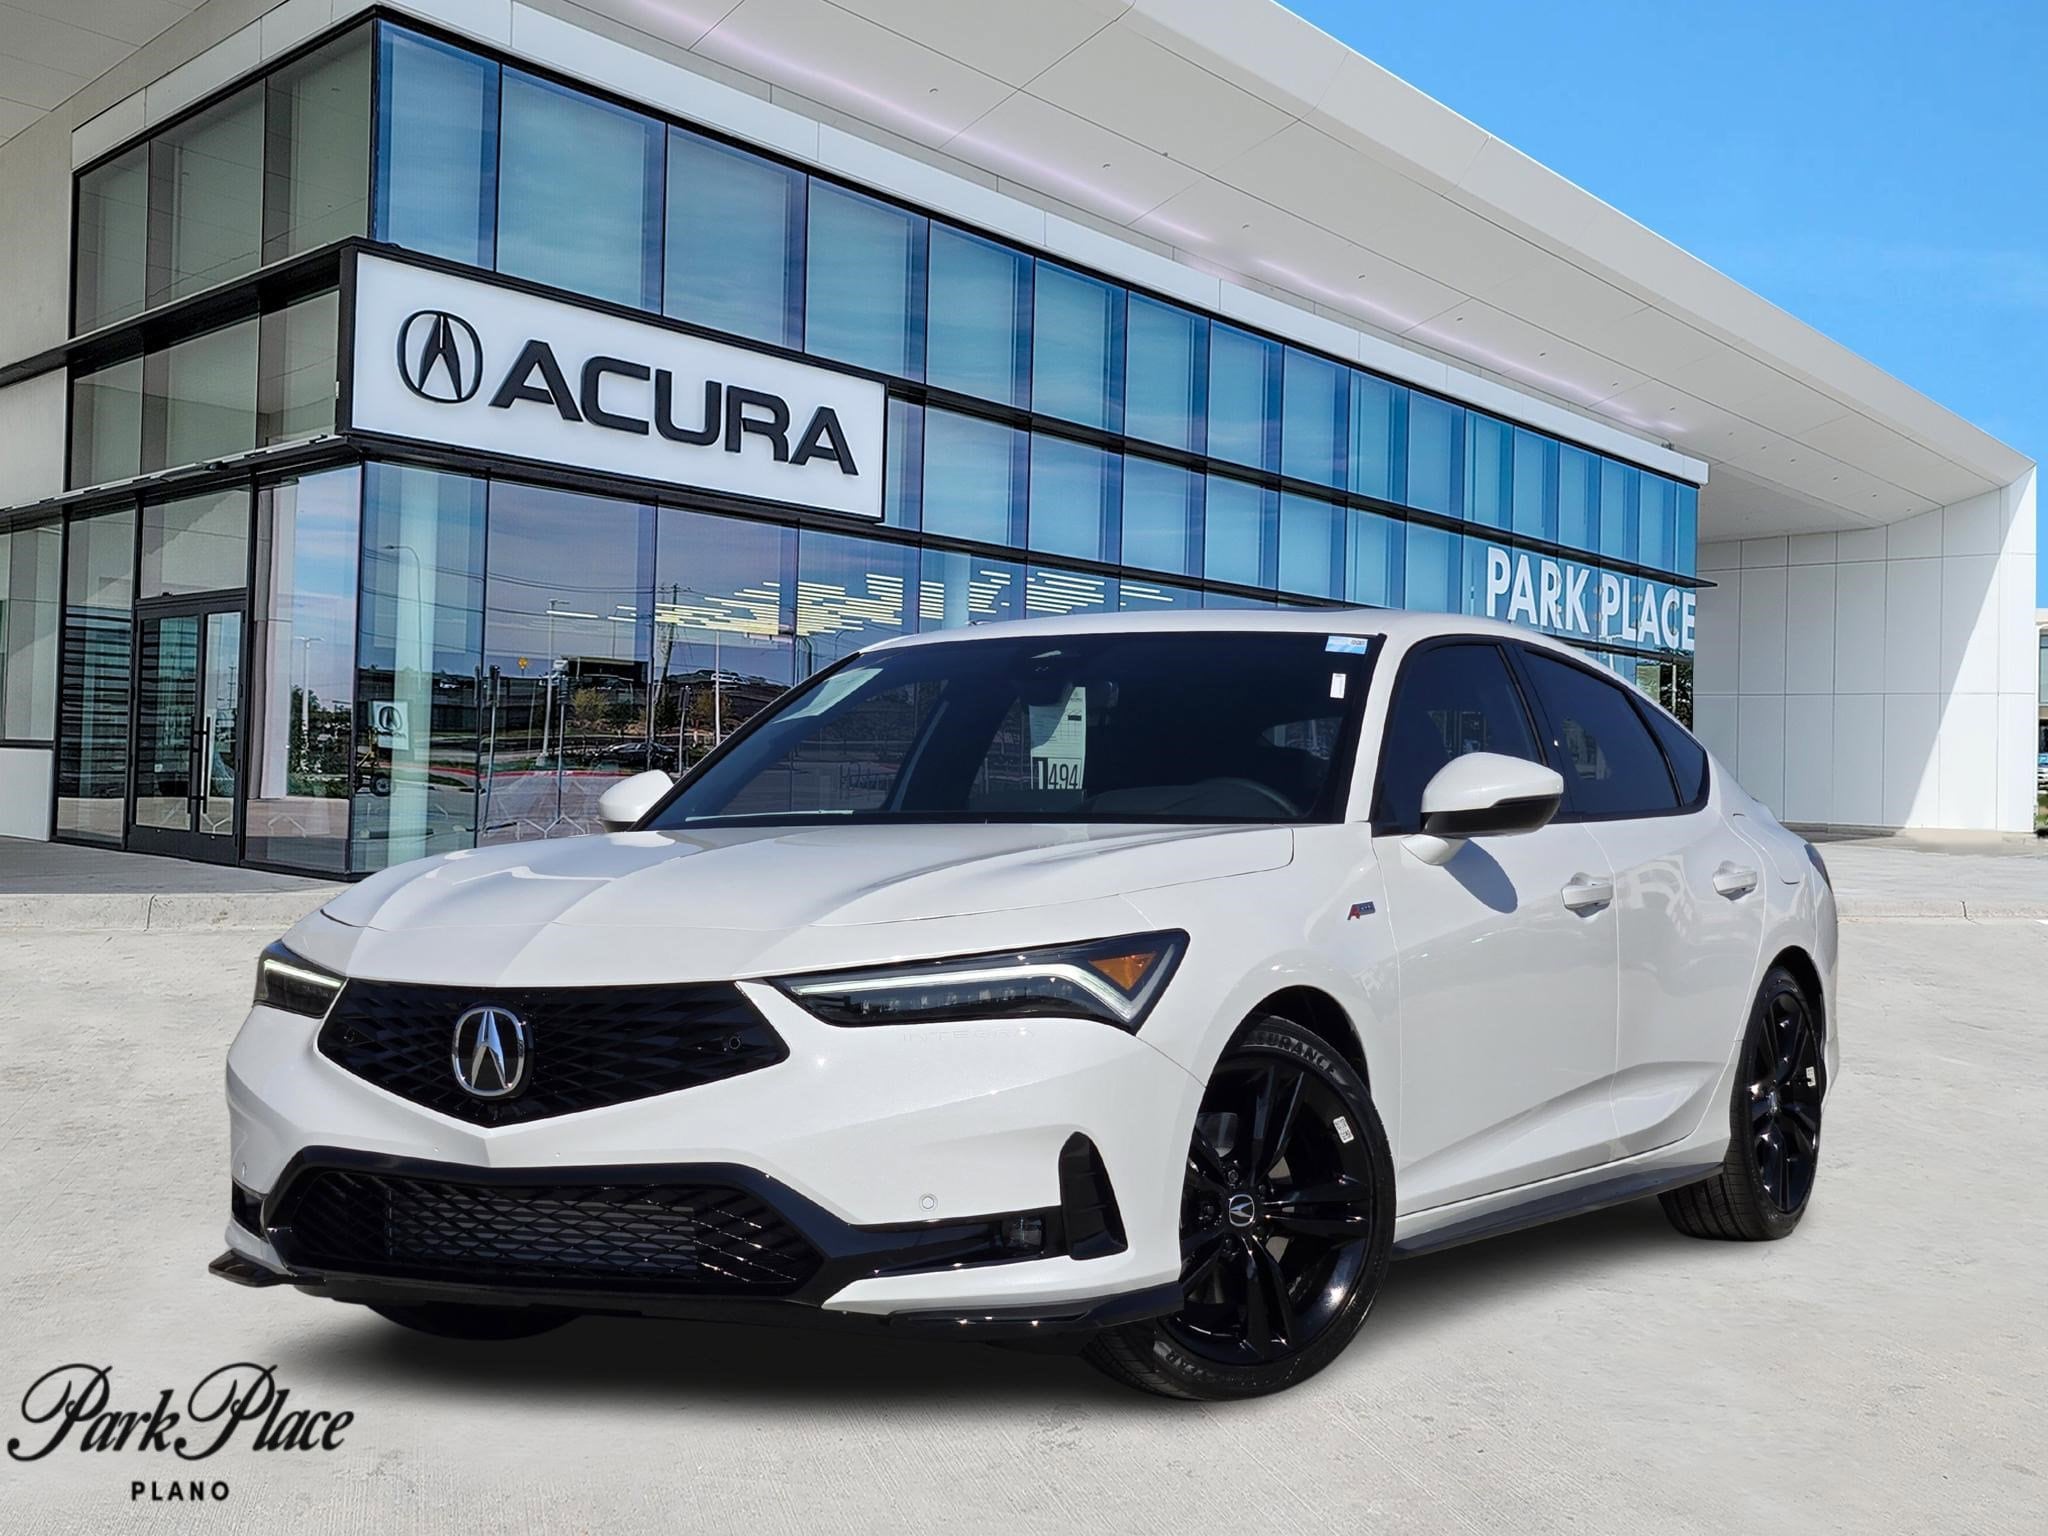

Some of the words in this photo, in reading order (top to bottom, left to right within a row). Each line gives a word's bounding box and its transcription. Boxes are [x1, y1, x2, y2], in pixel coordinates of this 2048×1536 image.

[488, 339, 859, 476] ACURA
[1486, 546, 1590, 634] PARK
[1600, 572, 1697, 651] PLACE
